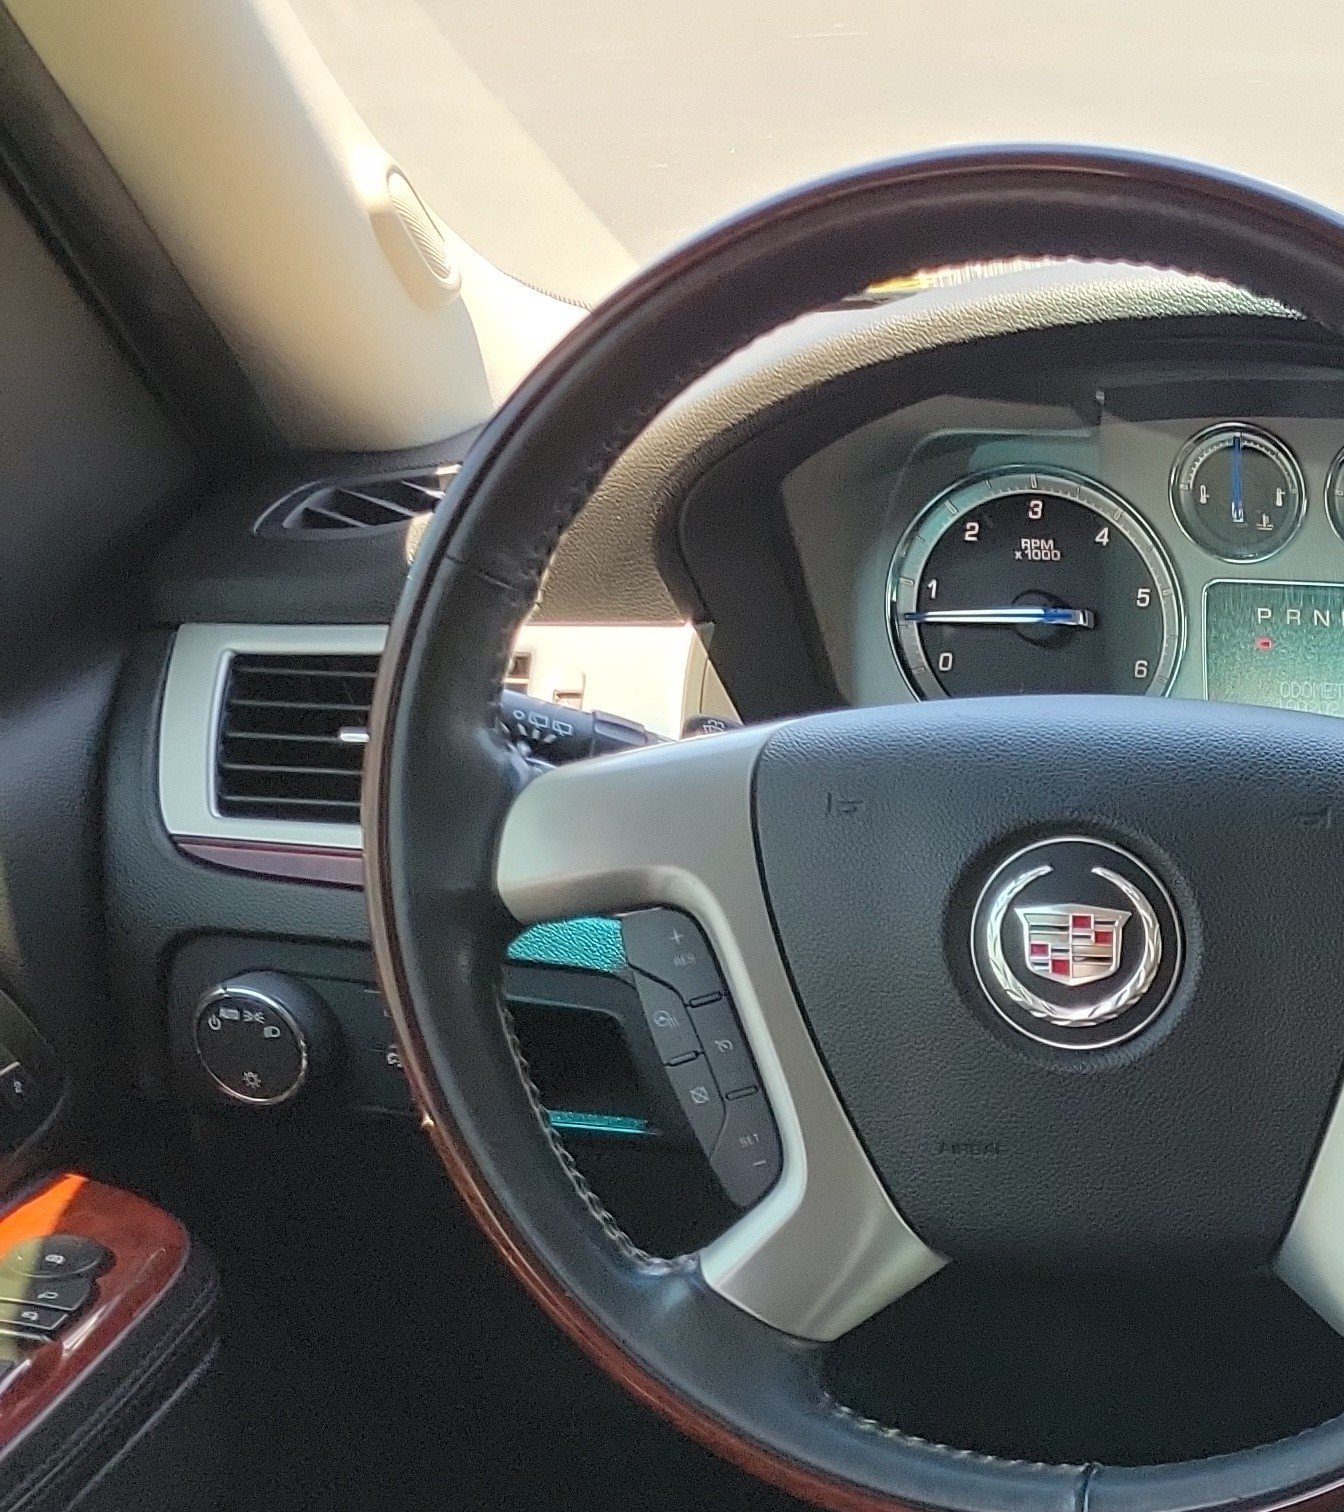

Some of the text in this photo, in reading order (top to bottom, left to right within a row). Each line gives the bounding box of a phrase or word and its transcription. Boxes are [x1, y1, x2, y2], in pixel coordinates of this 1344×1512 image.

[1028, 500, 1044, 520] 3
[964, 522, 980, 542] 2
[1094, 527, 1110, 546] 4
[1020, 538, 1055, 550] RPM
[927, 579, 938, 599] 1
[1136, 588, 1150, 607] 5
[1257, 607, 1272, 625] P
[1286, 608, 1301, 625] R
[1313, 609, 1330, 628] N
[938, 652, 953, 671] 0
[1134, 660, 1148, 679] 6
